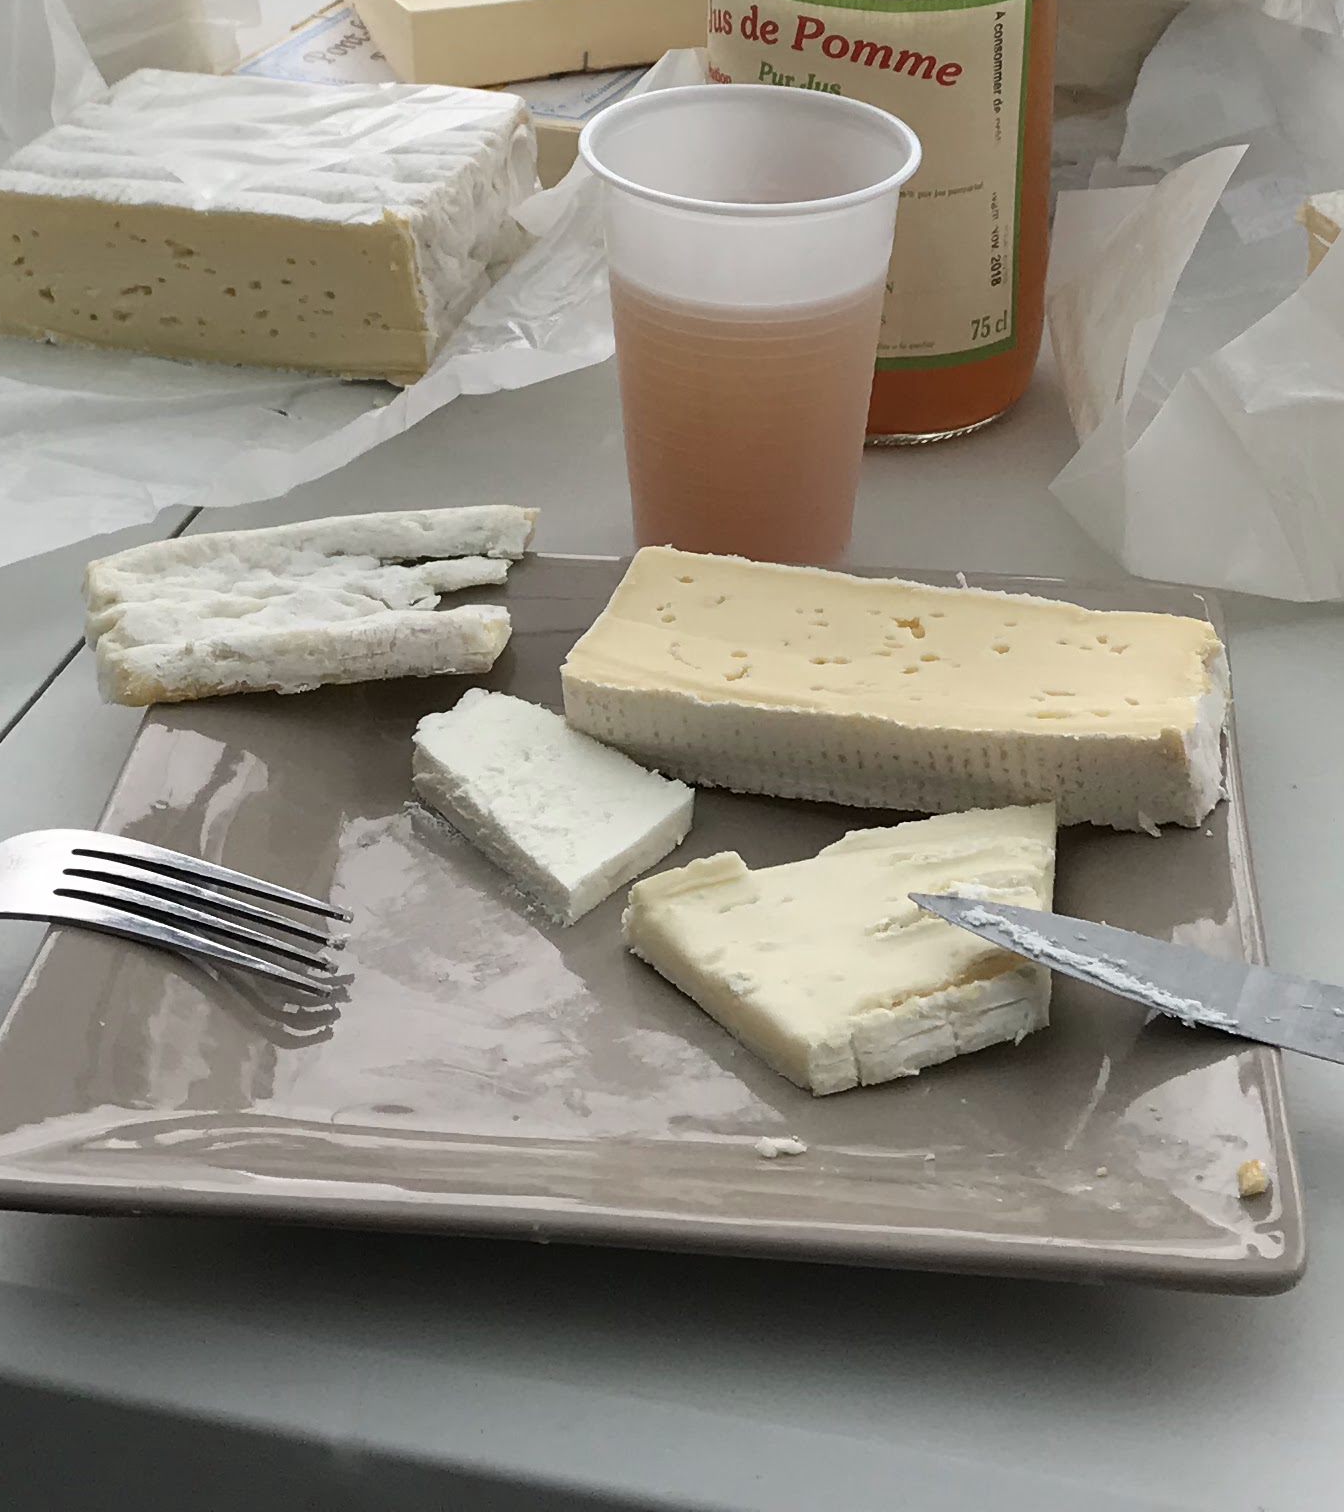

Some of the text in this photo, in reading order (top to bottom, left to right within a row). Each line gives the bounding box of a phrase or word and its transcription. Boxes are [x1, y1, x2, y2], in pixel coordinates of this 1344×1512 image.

[740, 4, 780, 45] de
[790, 14, 964, 87] Pomme
[992, 22, 1004, 96] consommer
[758, 60, 842, 96] Pur Jus
[990, 254, 1002, 287] 2018
[971, 310, 1008, 340] 75 cl
